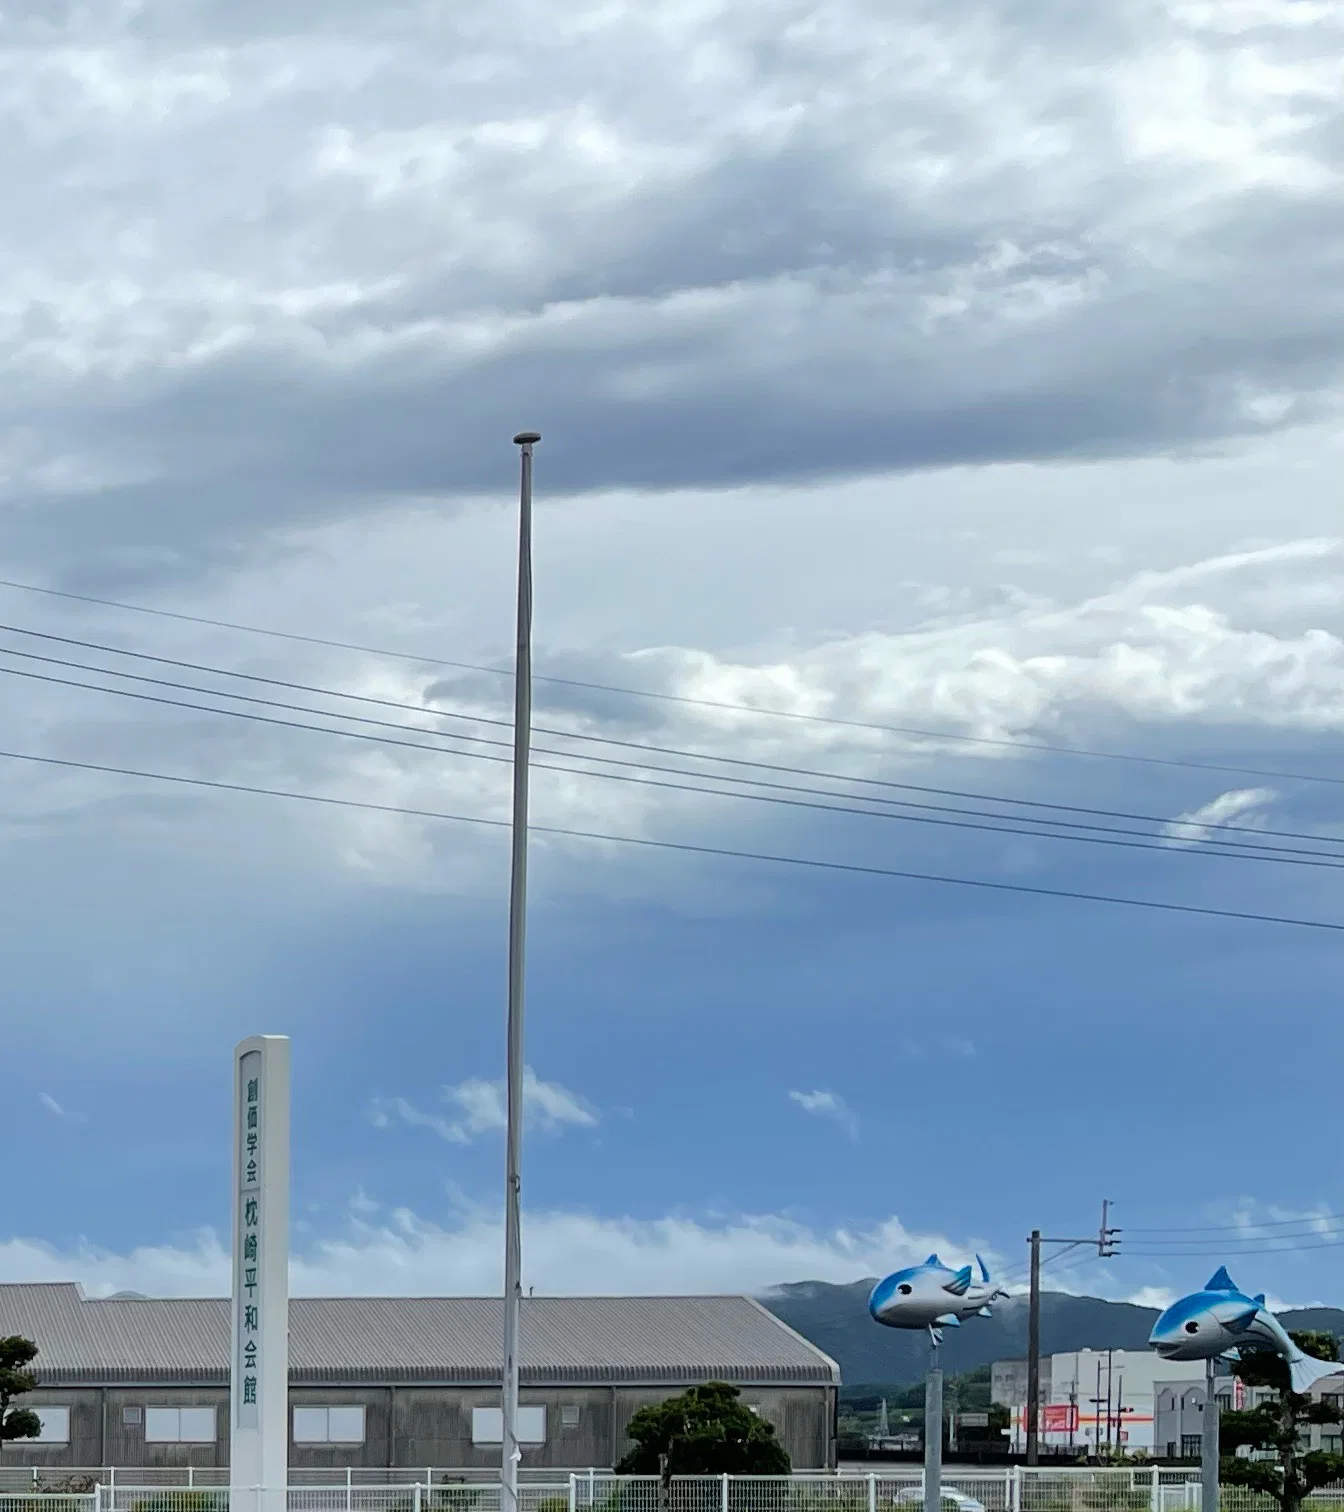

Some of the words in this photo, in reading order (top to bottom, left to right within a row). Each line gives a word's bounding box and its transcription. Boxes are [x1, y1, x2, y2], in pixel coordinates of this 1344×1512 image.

[246, 1077, 259, 1183] 創価学会
[243, 1196, 259, 1405] 枕崎平和会館
